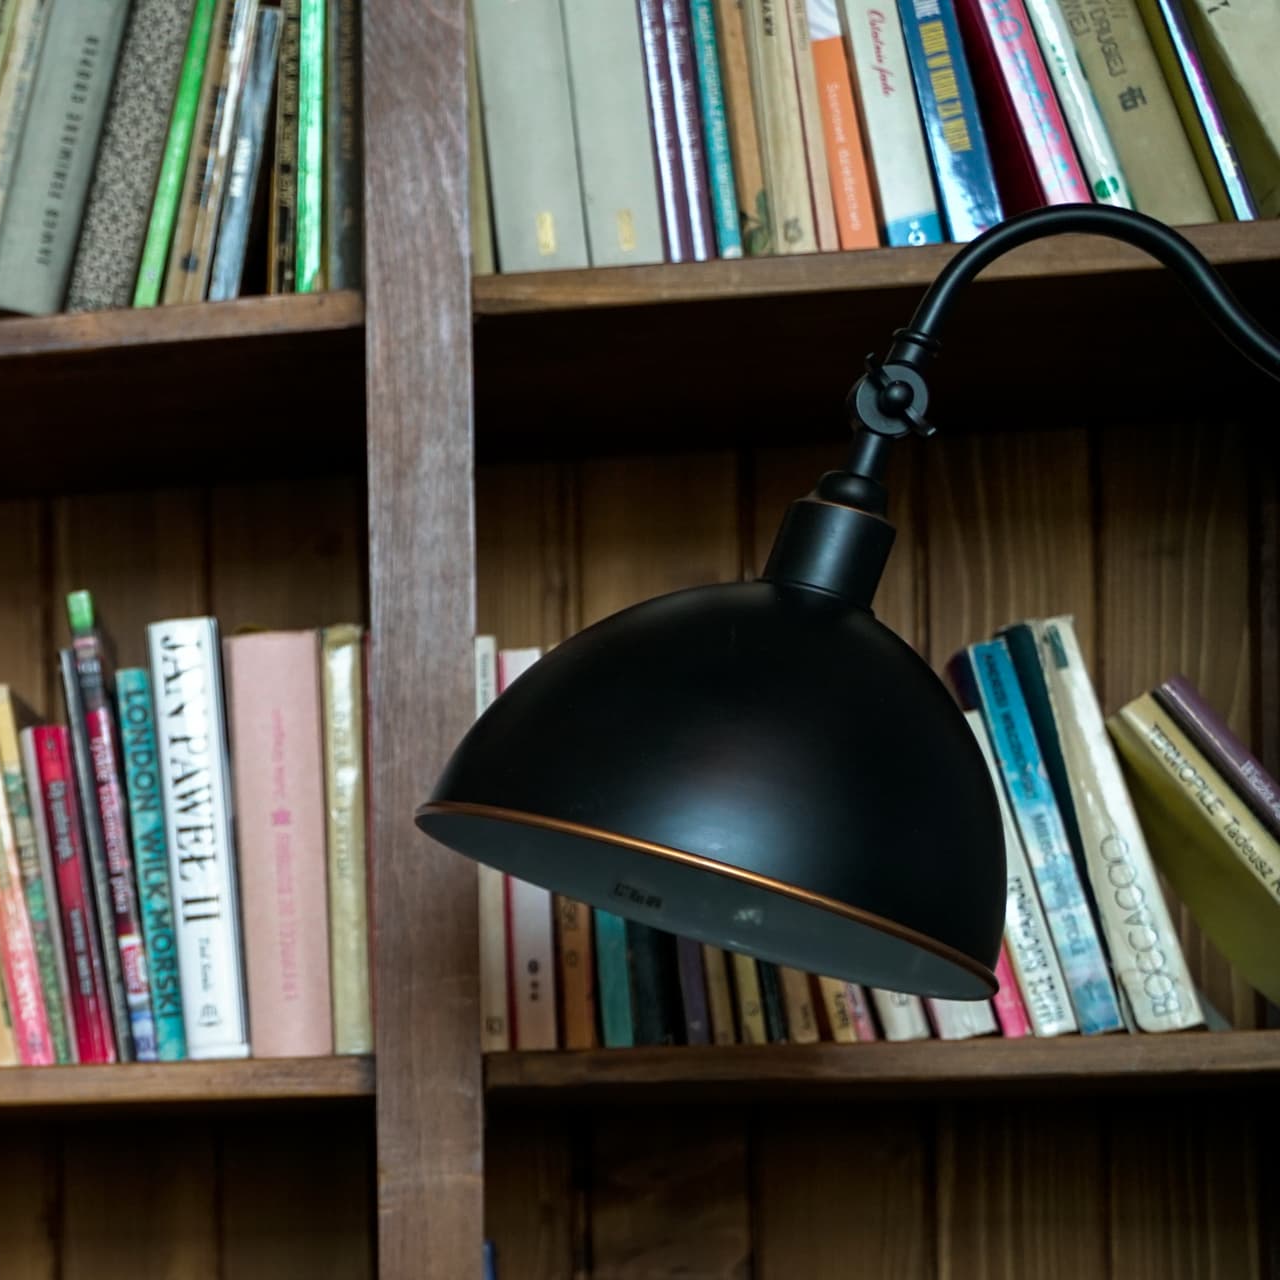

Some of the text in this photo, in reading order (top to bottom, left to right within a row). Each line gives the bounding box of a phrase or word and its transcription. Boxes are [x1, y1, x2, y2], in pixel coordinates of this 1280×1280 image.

[1089, 6, 1127, 78] DRUGIEJ
[31, 34, 102, 266] JAMES FENIMORE COOPER
[123, 688, 181, 1018] LONDON WILK MORSKI
[159, 632, 223, 926] JAN PAWEŁ II
[1142, 716, 1275, 881] TERMOPILE Tadeusz
[1060, 912, 1086, 956] STOLE
